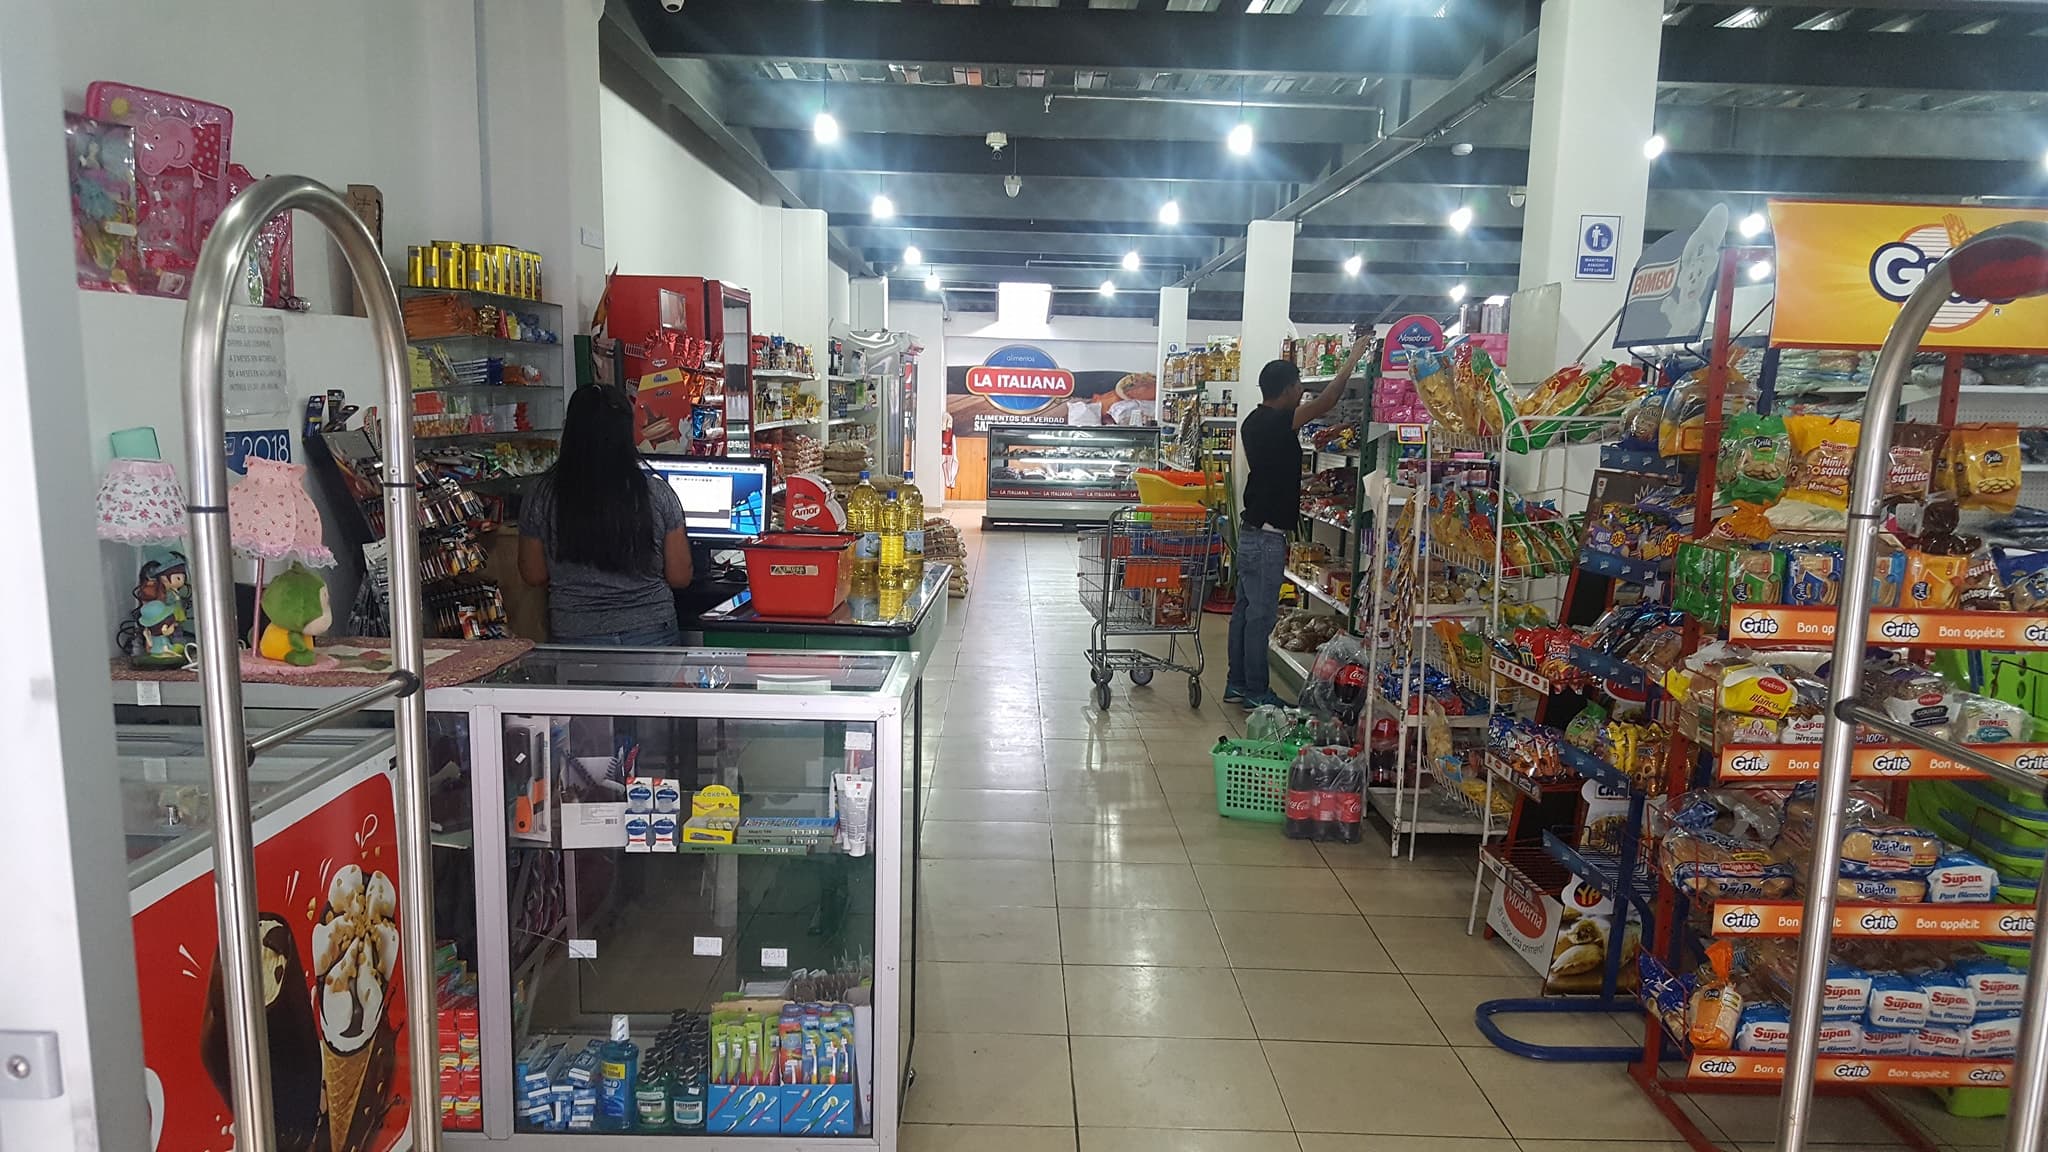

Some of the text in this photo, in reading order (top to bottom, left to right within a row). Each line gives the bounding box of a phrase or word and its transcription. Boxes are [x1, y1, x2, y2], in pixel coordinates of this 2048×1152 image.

[1631, 267, 1675, 296] BIMBO
[1397, 333, 1432, 343] Nosotras
[1006, 354, 1035, 363] alimentos
[973, 373, 1067, 391] LA ITALIANA
[974, 414, 1065, 424] ALIMENTOS DE VERDAD
[241, 434, 289, 467] 2018
[793, 507, 819, 517] Amor
[1741, 617, 1778, 634] Grilé
[1797, 621, 1819, 634] Bon
[1882, 621, 2005, 640] Grilé Bon appétit
[2025, 626, 2048, 641] Gri
[1749, 693, 1779, 709] Blanco
[1788, 759, 1809, 769] Bon
[1873, 756, 1911, 771] Grilé
[1929, 758, 1950, 770] Bon
[1871, 839, 1912, 854] Rey-Pan
[1941, 872, 1982, 886] Supan
[1856, 881, 1896, 896] Rey-Pan
[1938, 891, 1989, 900] Pan Blanco
[1723, 912, 1799, 928] Grilé Bon
[1861, 913, 1981, 931] Grilé Bon appétit
[1823, 984, 1862, 998] Supan
[1979, 979, 2021, 993] Supan
[1883, 995, 1924, 1010] Supan
[1931, 991, 1970, 1005] Supan
[1994, 999, 2024, 1007] Blanco
[1836, 1003, 1866, 1012] Blanco
[1877, 1015, 1925, 1025] Pan Blanco
[1943, 1011, 1973, 1021] Blanco
[1917, 1029, 1961, 1045] Supan
[1970, 1028, 2011, 1041] Supan
[1700, 1060, 1736, 1073] Grilé
[1753, 1064, 1774, 1073] Bon
[1834, 1064, 1950, 1080] Grilé Bon appétit
[1969, 1070, 2005, 1082] Grilé
